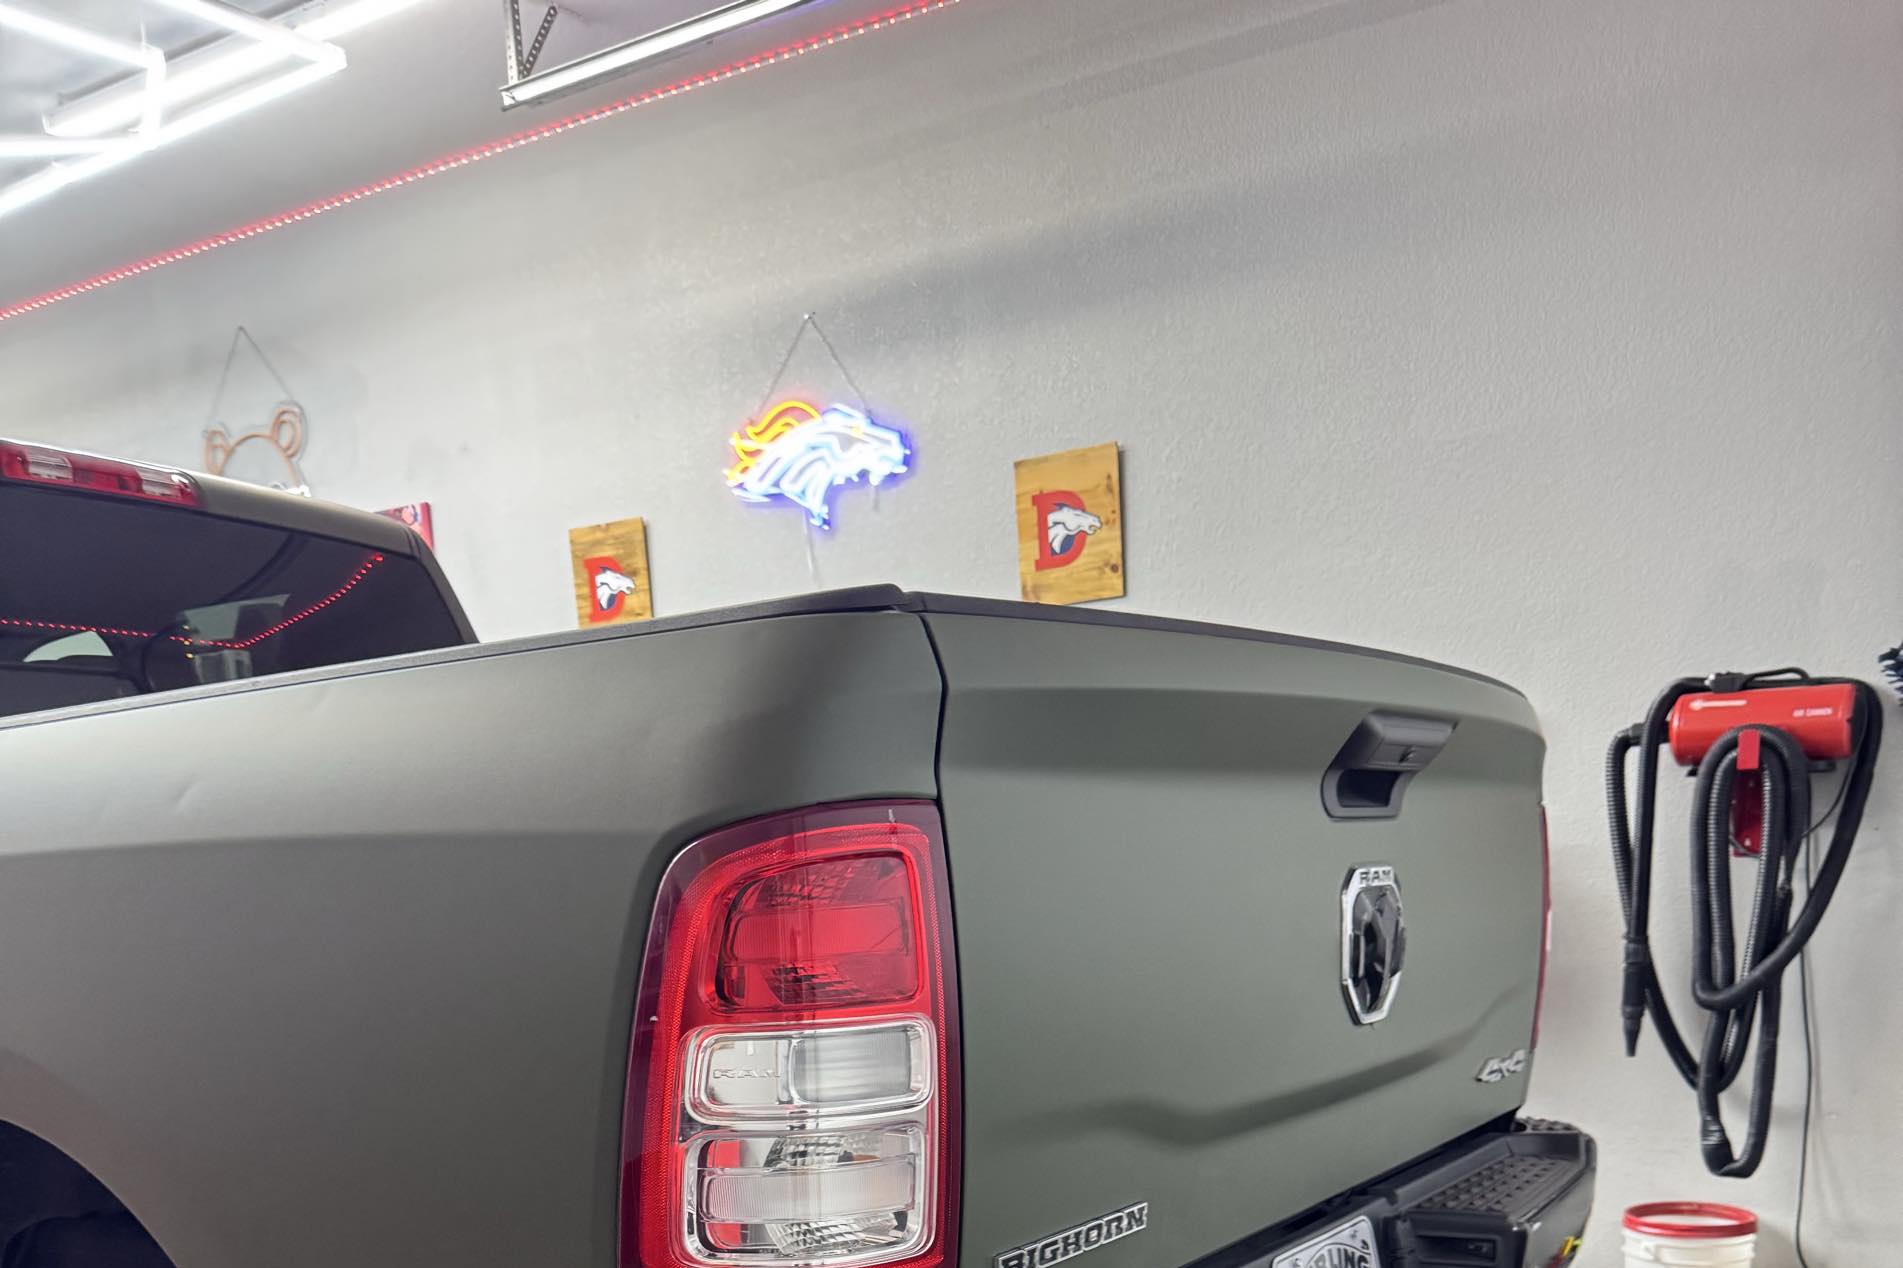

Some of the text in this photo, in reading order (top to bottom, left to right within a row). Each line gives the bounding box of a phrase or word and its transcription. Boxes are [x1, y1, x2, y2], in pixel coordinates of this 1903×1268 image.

[1031, 490, 1088, 572] D
[583, 556, 627, 623] D
[1359, 869, 1392, 885] RAM
[713, 1067, 780, 1079] RAM
